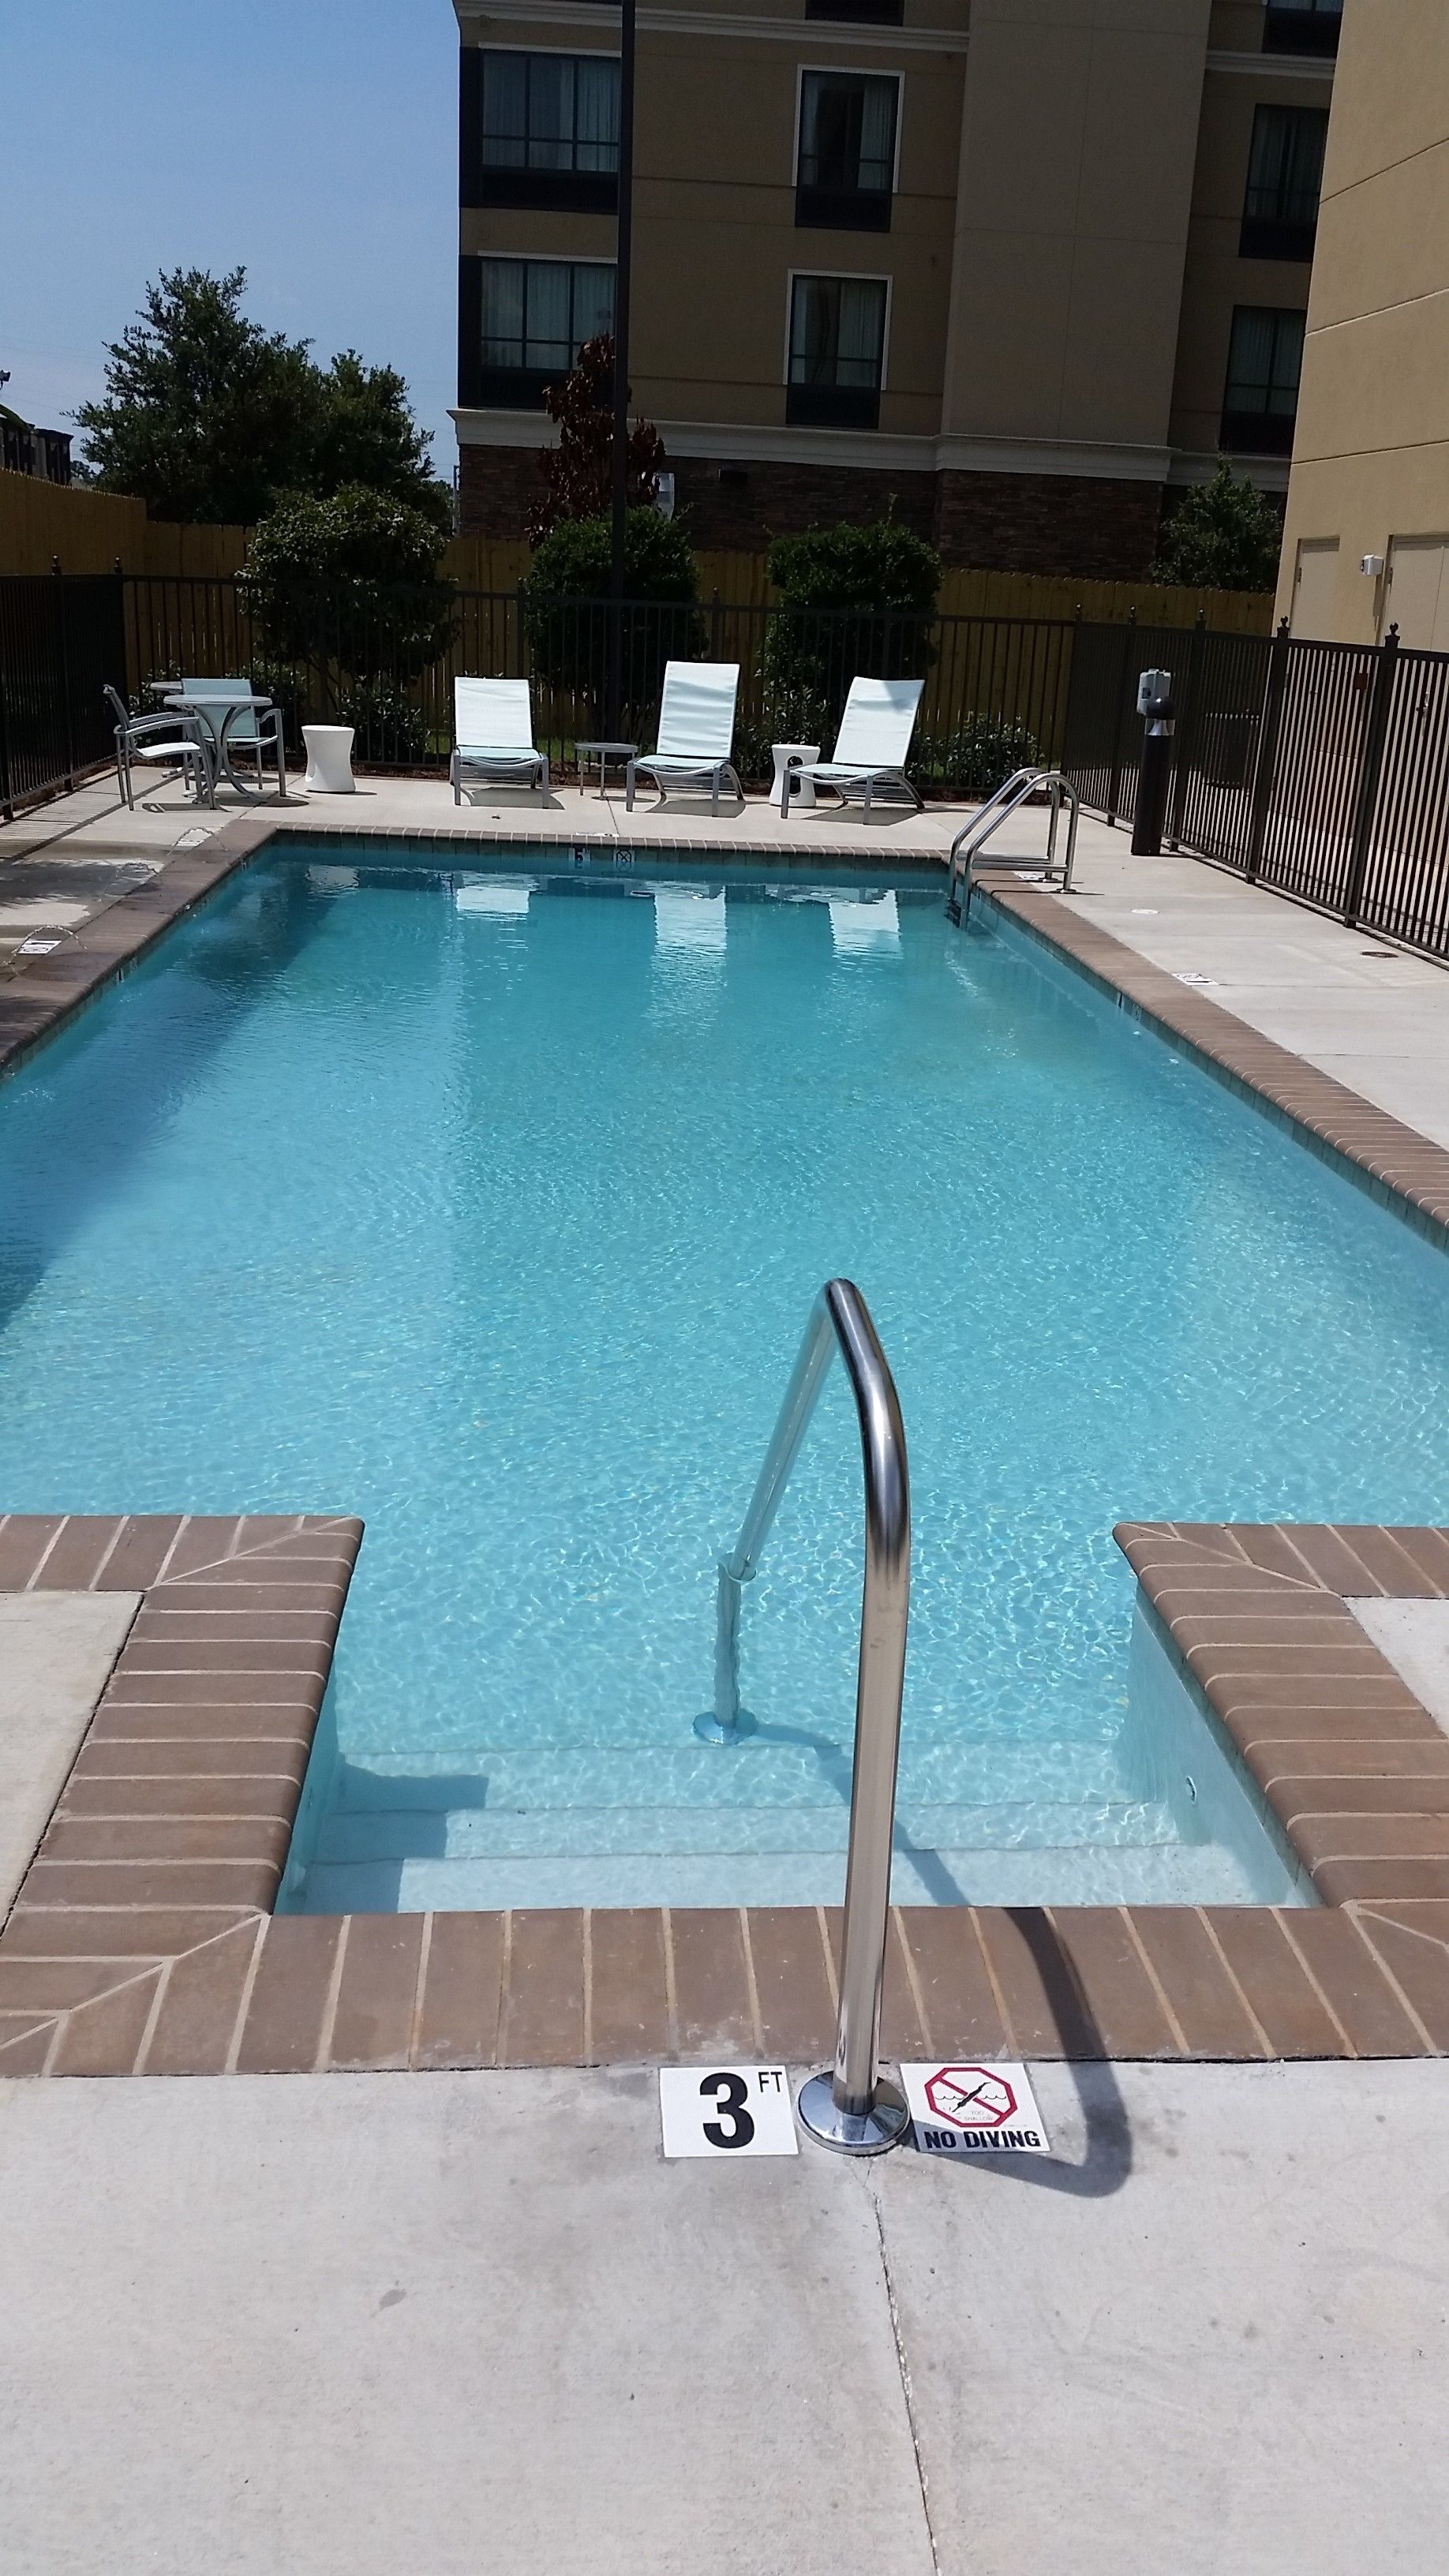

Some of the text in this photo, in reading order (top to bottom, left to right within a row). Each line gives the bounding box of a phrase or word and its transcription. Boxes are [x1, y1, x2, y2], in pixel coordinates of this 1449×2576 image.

[699, 2071, 783, 2149] 3 FT
[924, 2130, 1042, 2149] NO DIVING
